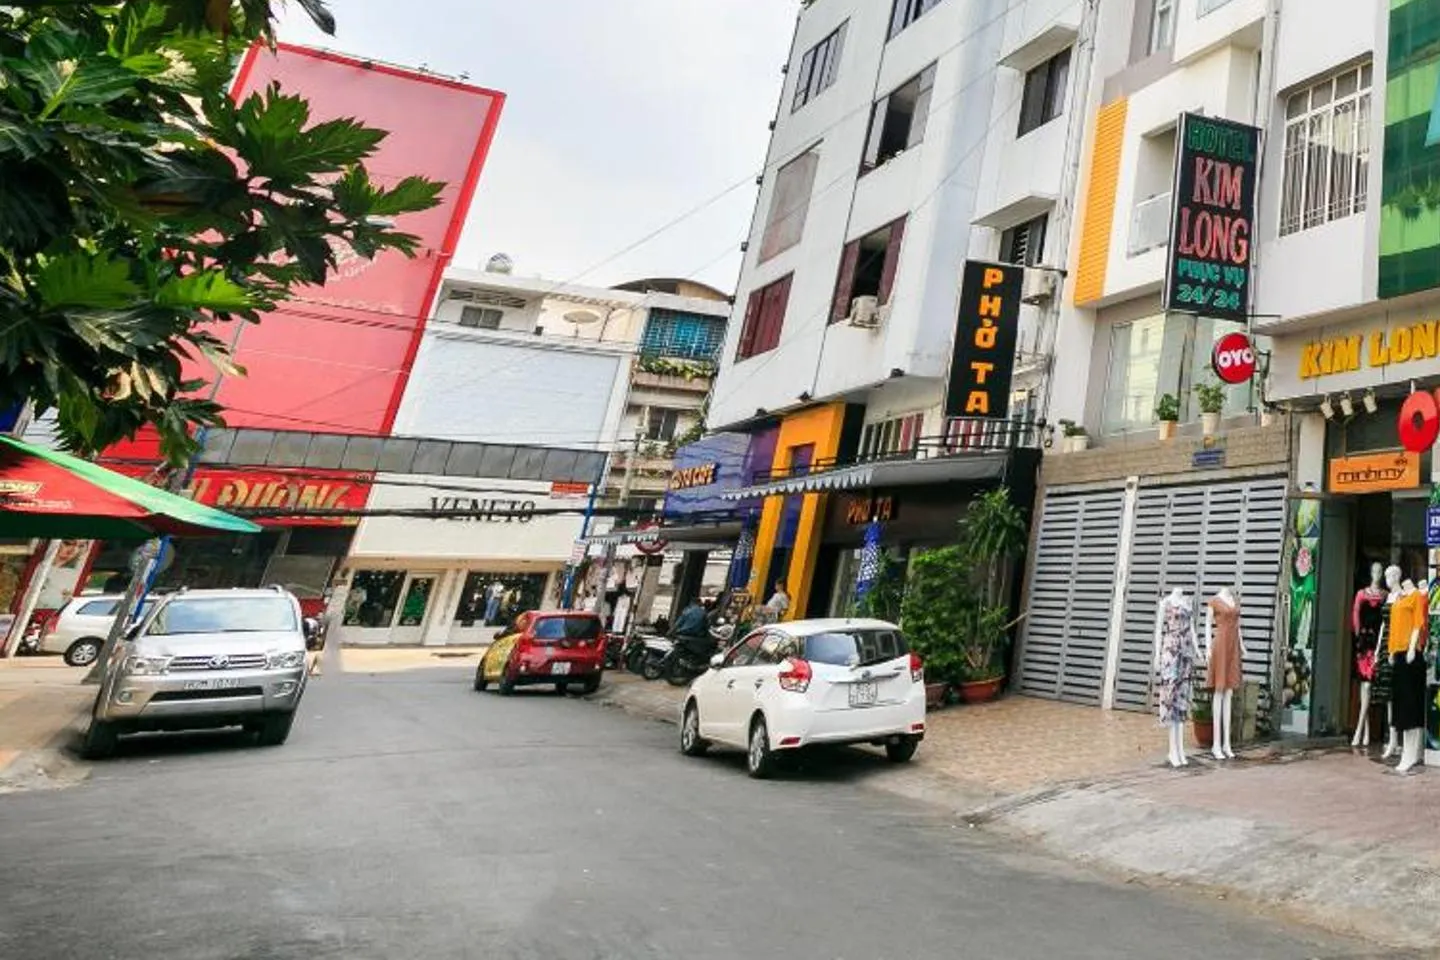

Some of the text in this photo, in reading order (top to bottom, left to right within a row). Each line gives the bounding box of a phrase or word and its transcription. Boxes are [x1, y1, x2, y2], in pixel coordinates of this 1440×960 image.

[1192, 156, 1244, 210] KIM
[1178, 206, 1249, 264] LONG
[1176, 283, 1240, 310] 24/24
[1219, 346, 1255, 369] OYO
[1300, 334, 1363, 379] KIM
[965, 361, 994, 415] TA
[428, 495, 537, 525] VENETO
